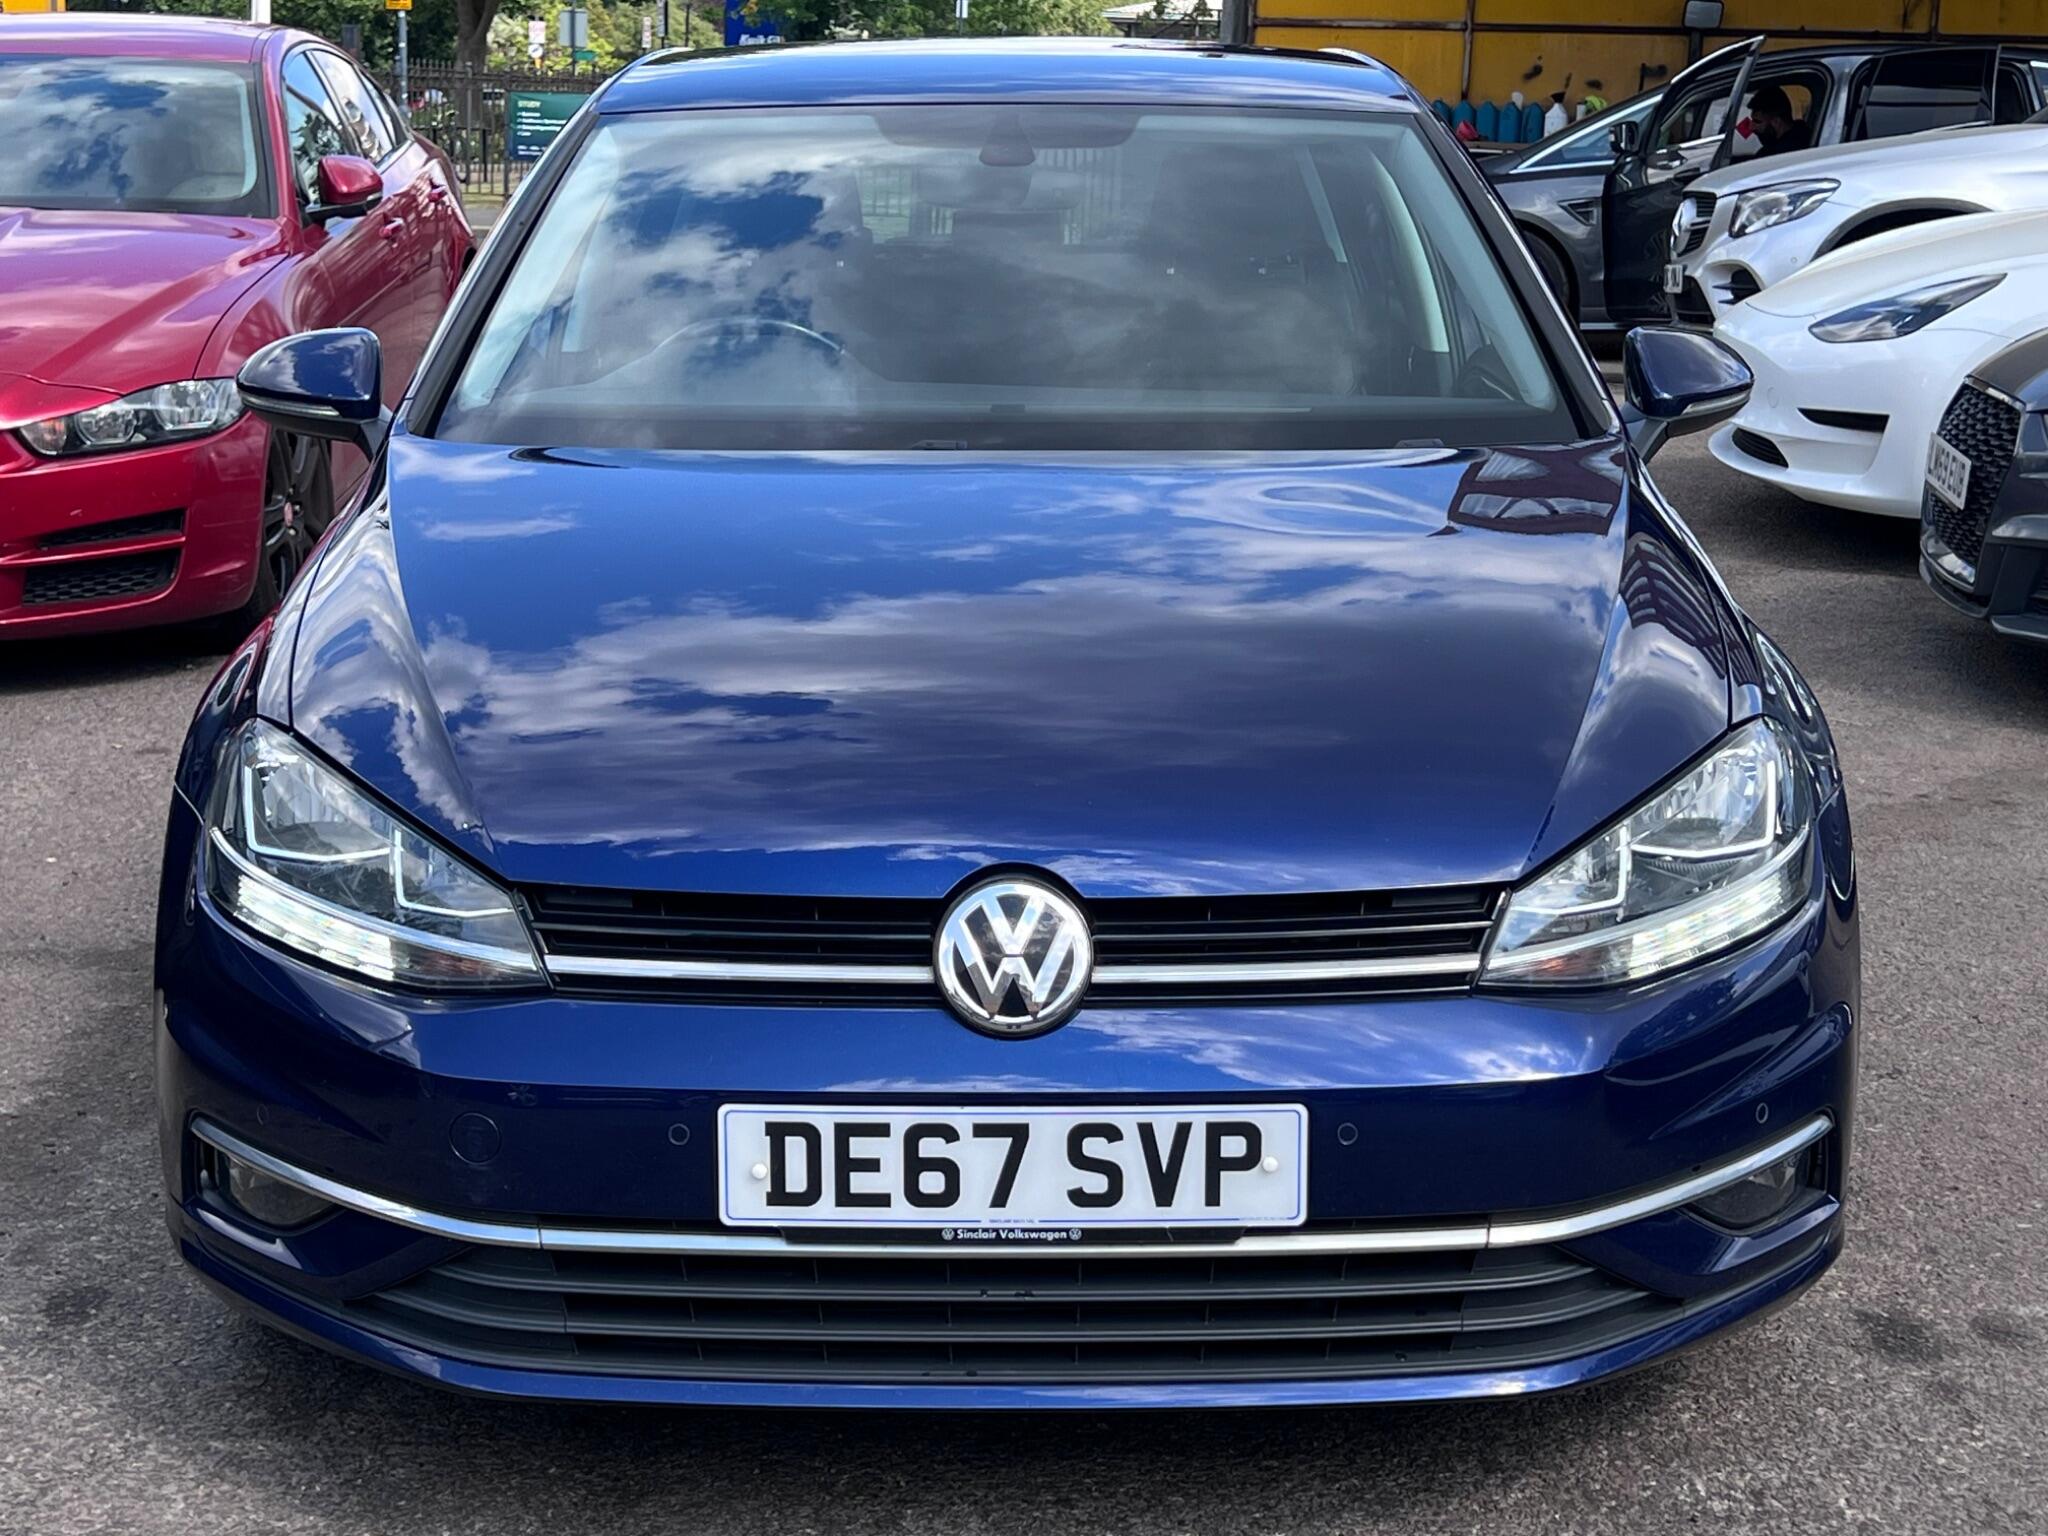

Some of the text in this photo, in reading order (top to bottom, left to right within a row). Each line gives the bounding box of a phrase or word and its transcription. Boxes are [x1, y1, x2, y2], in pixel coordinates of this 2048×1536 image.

[944, 884, 1084, 1024] VW
[764, 1120, 1263, 1208] DE67 SVP
[956, 1229, 997, 1239] Sinclair
[1000, 1229, 1068, 1241] Volkswagen
